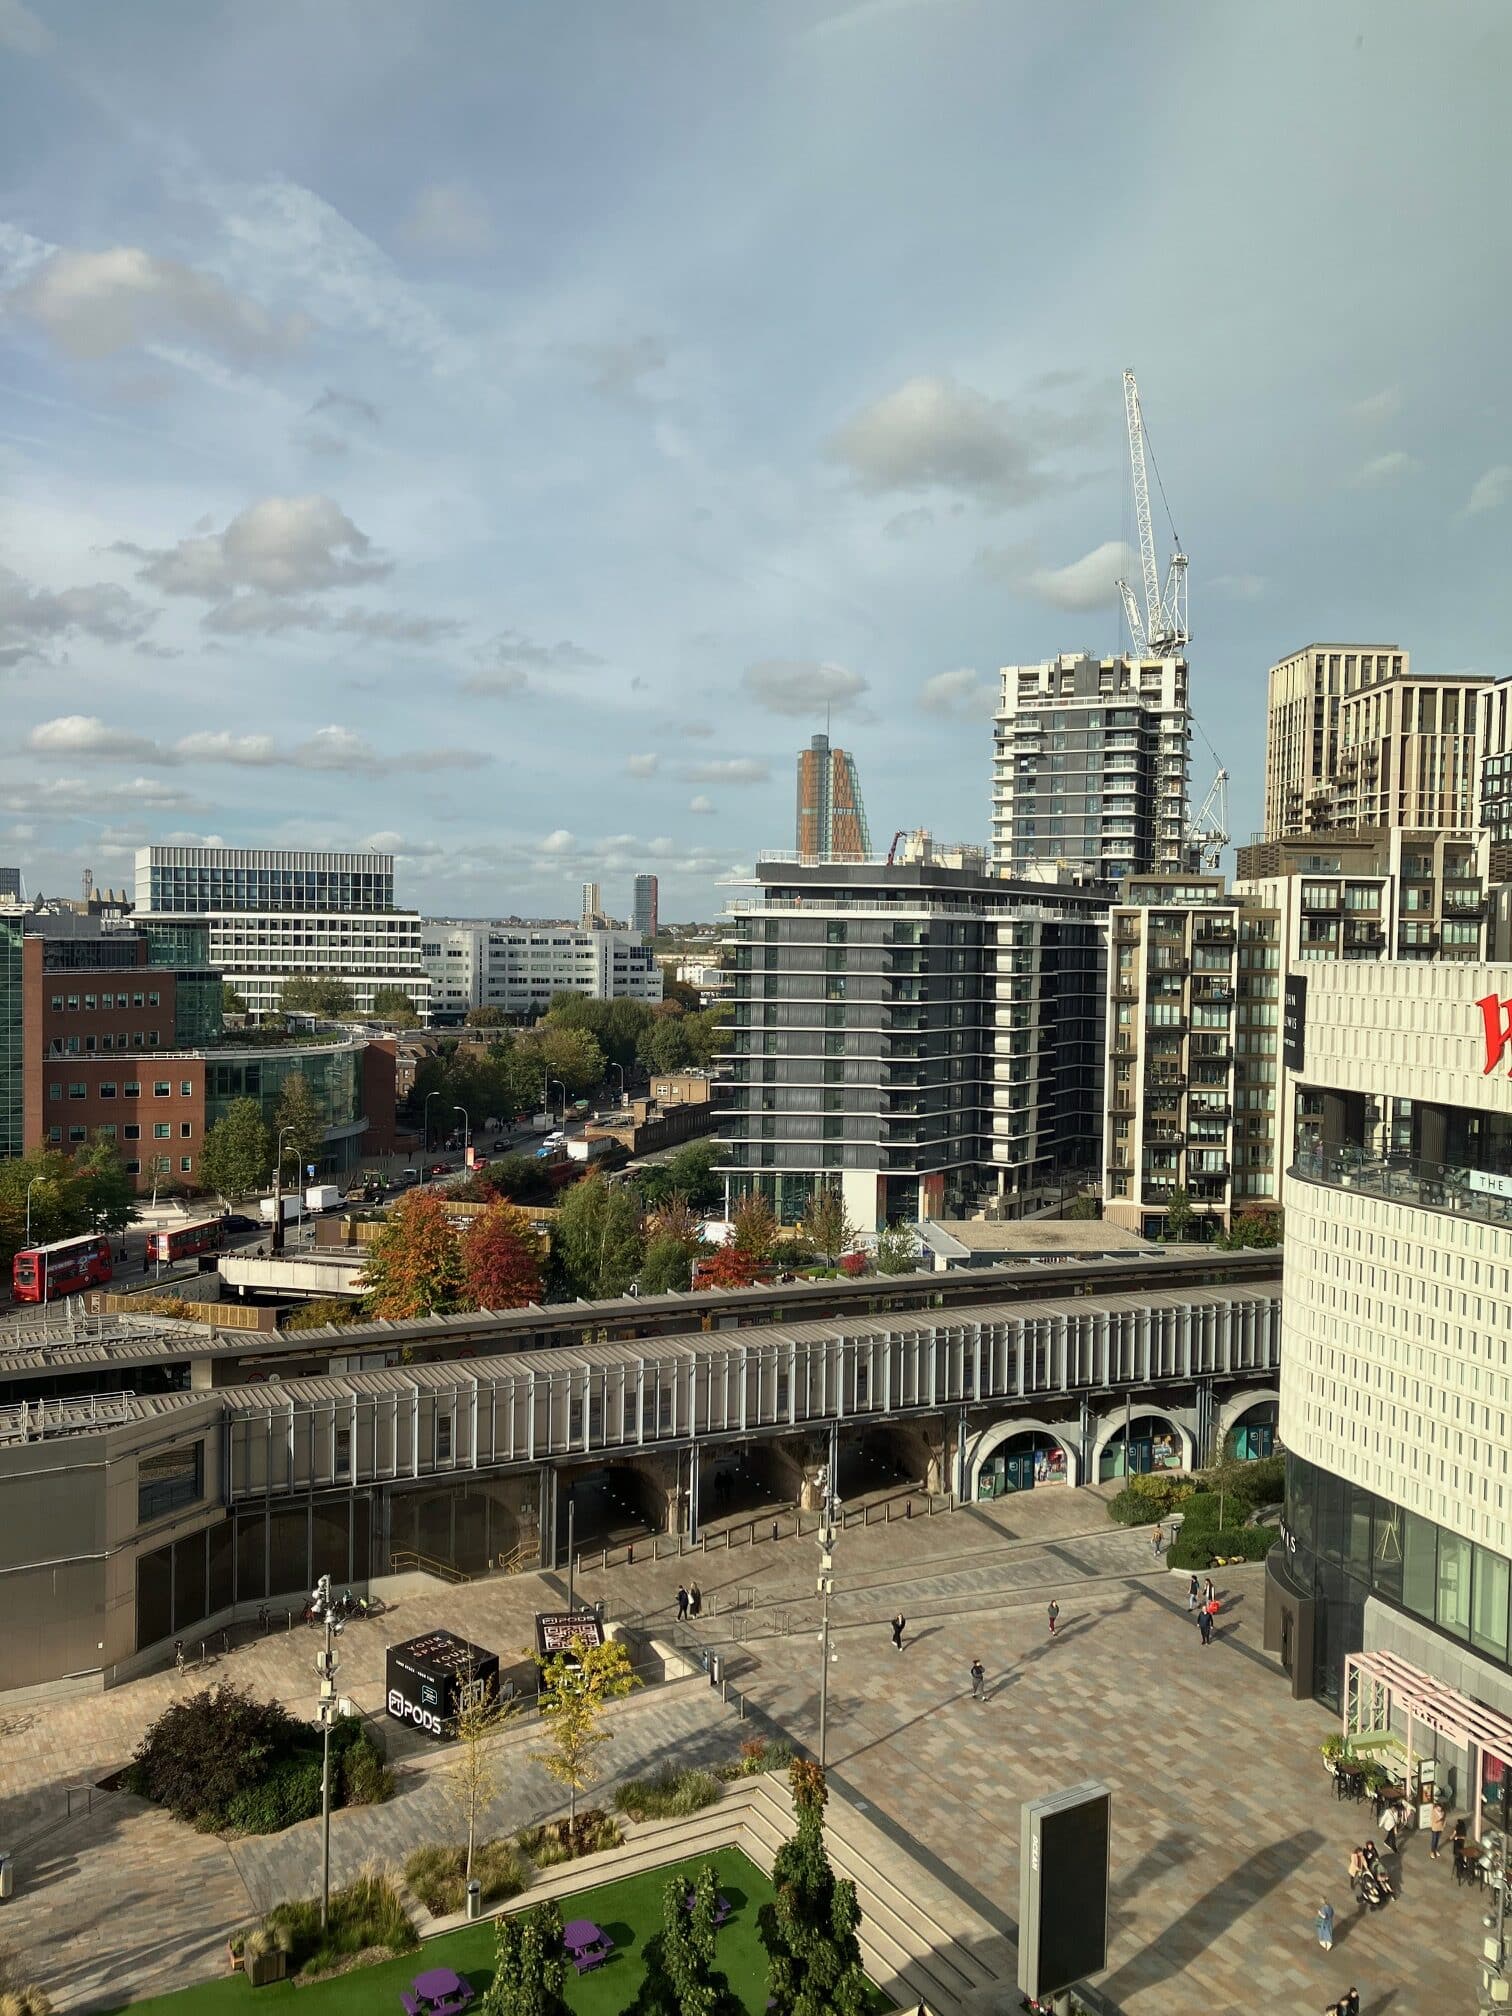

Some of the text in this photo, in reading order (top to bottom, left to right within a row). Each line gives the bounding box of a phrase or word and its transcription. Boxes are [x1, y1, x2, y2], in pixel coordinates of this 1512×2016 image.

[1480, 1176, 1503, 1191] THE
[407, 1636, 442, 1651] YOUR
[432, 1648, 466, 1664] YOUR
[404, 1701, 442, 1735] PODS
